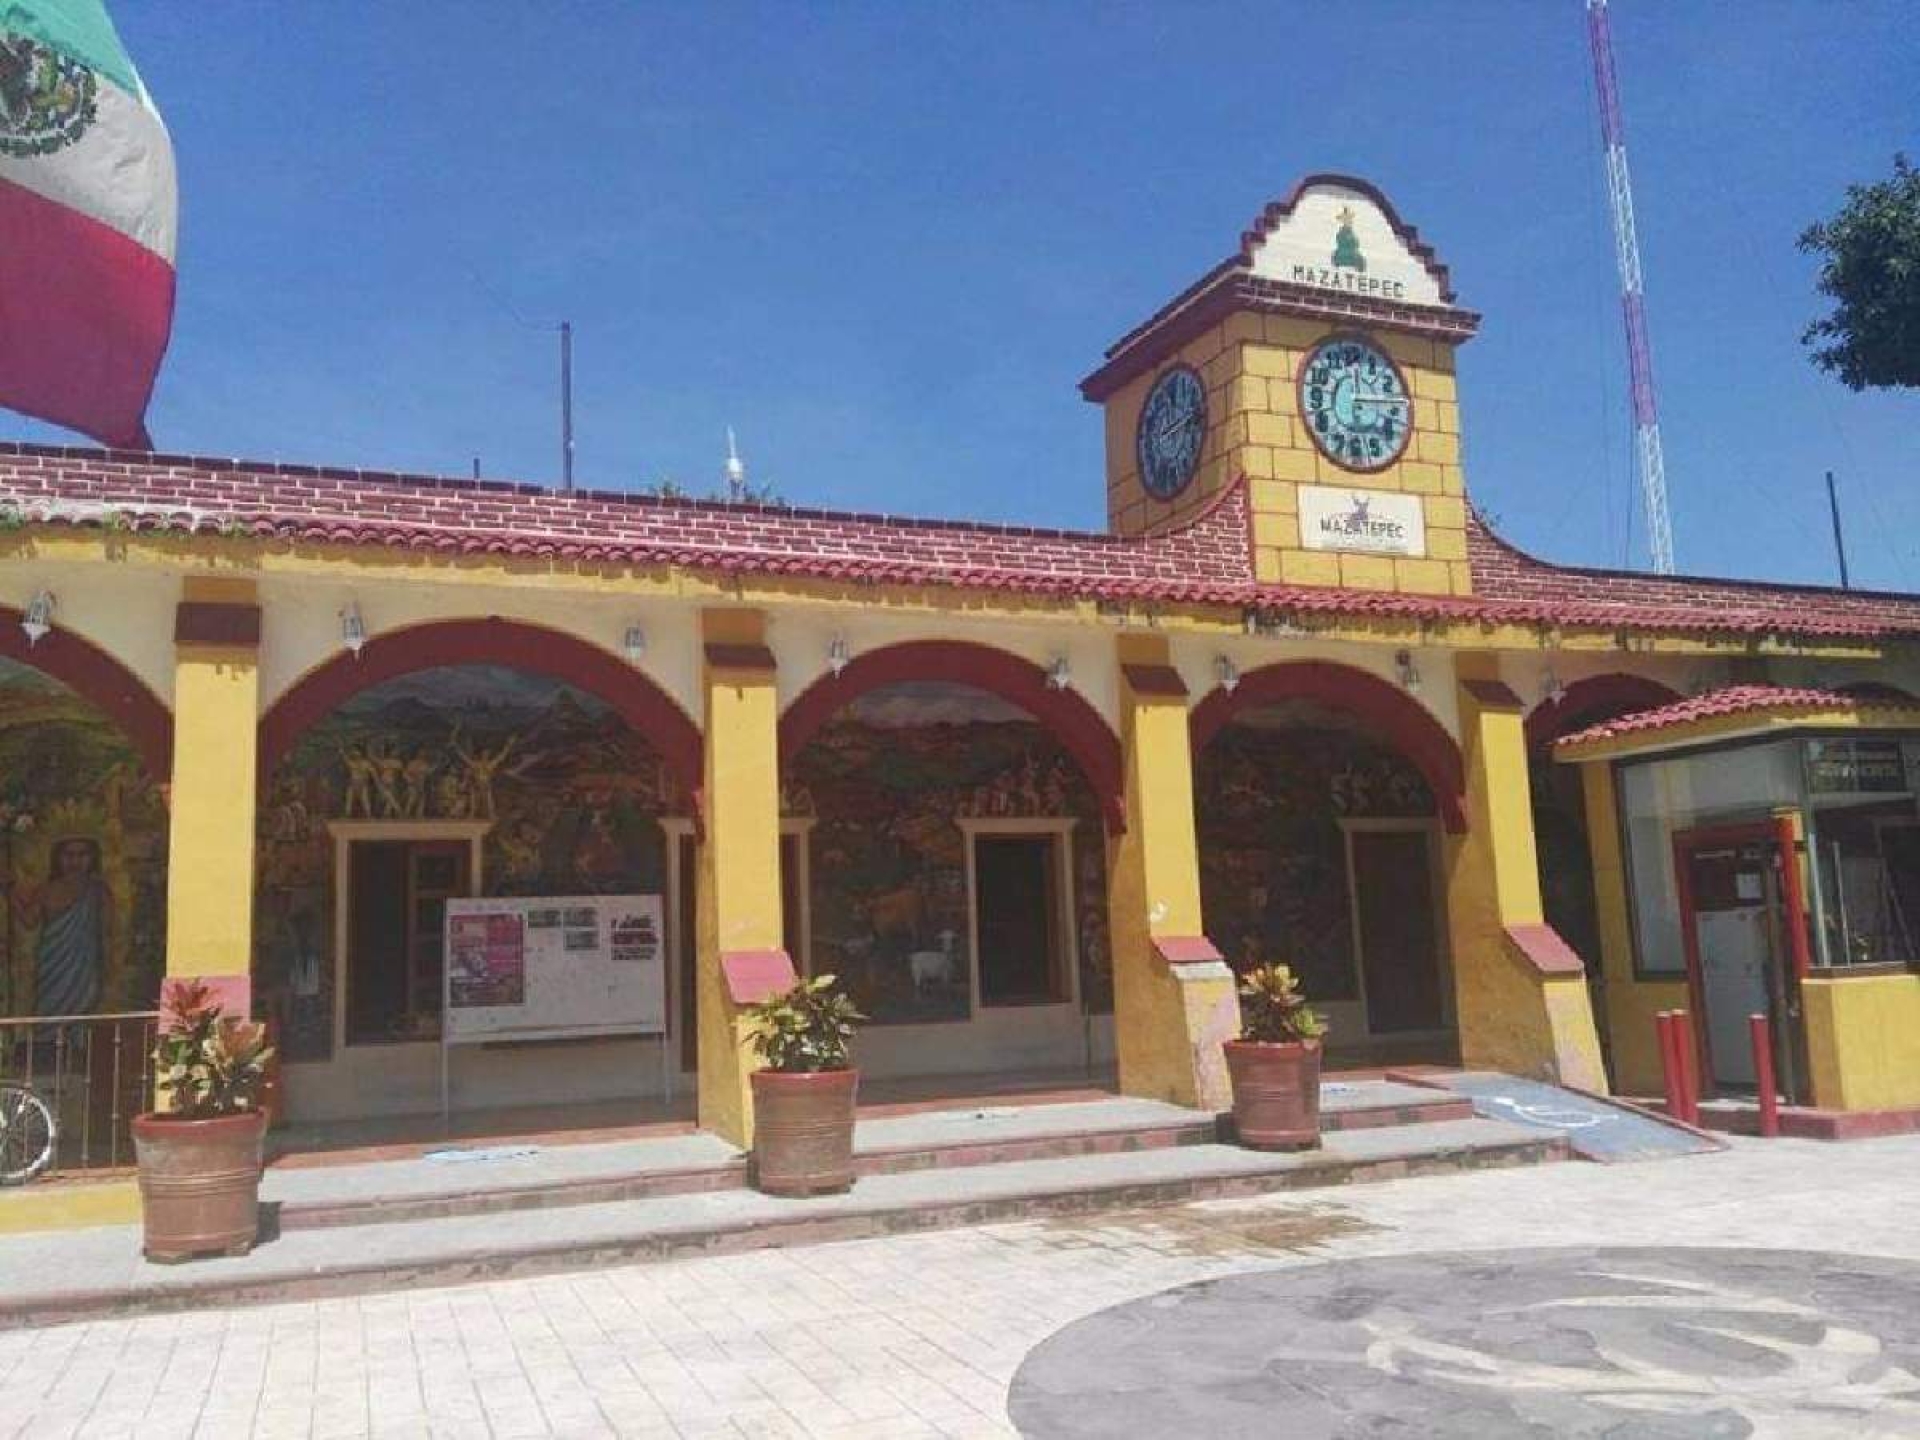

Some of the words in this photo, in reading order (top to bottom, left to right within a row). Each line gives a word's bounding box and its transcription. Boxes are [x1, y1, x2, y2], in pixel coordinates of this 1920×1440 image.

[1293, 264, 1404, 298] MAZATEPEC
[1310, 386, 1323, 409] 9
[1320, 518, 1404, 539] MAZATEPEC
